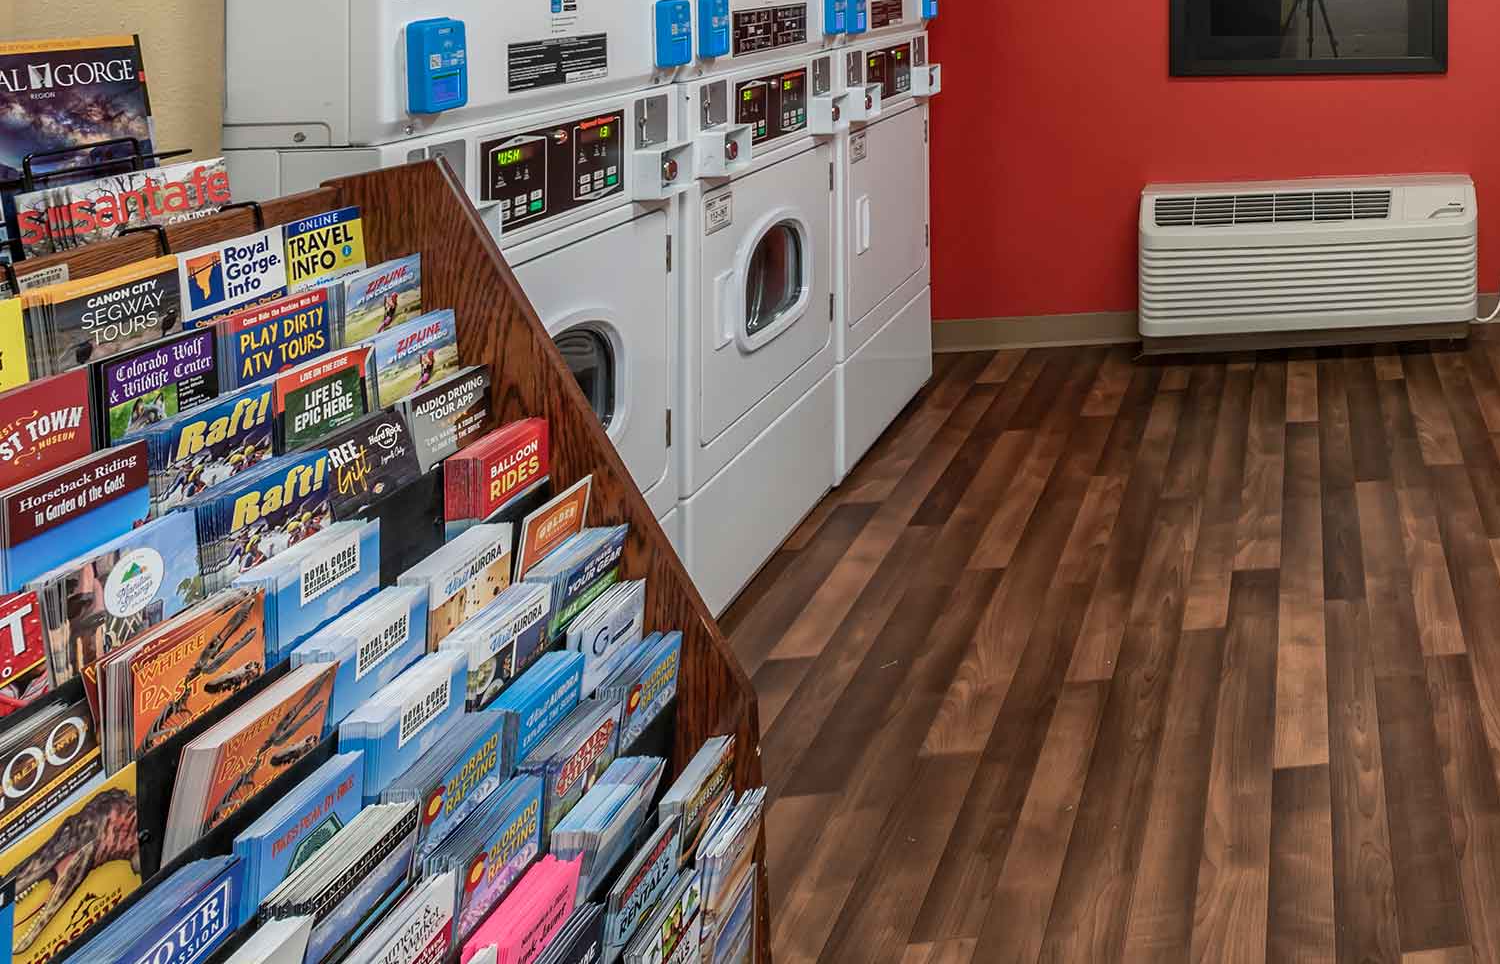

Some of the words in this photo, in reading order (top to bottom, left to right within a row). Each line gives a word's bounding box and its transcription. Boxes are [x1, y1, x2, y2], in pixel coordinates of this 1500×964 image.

[54, 59, 135, 87] GORGE
[288, 225, 353, 259] TRAVEL
[298, 212, 339, 233] ONLINE
[223, 236, 269, 263] Royal
[226, 253, 281, 281] Gorge.
[293, 251, 336, 280] INFO
[87, 289, 130, 308] CANON
[132, 279, 158, 298] CITY
[228, 277, 261, 298] info
[365, 264, 408, 296] ZIPLINE
[81, 290, 164, 330] SEGWAY
[90, 311, 158, 345] TOURS
[240, 322, 277, 353] PLAY
[282, 306, 325, 337] DIRTY
[242, 353, 275, 379] ATV
[279, 331, 325, 365] TOURS
[396, 321, 441, 352] ZIPLINE
[115, 351, 168, 382] Colorado
[172, 335, 205, 361] Wolf
[122, 366, 169, 398] Wildlife
[174, 355, 213, 378] Center
[294, 407, 322, 433] EPIC
[323, 392, 354, 419] HERE
[304, 385, 329, 411] LIFE
[331, 380, 343, 399] IS
[415, 395, 446, 417] AUDIO
[447, 375, 484, 402] DRIVING
[429, 403, 455, 423] TOUR
[456, 392, 474, 411] APP
[25, 406, 84, 442] TOWN
[39, 431, 76, 449] MUSEUM
[176, 391, 272, 462] Raft!
[490, 440, 538, 479] BALLOON
[490, 456, 540, 502] RIDES
[18, 473, 92, 514] Horseback
[94, 455, 137, 478] Riding
[34, 512, 44, 528] in
[45, 497, 76, 522] Garden
[77, 492, 87, 509] of
[88, 486, 103, 502] the
[104, 473, 126, 496] Gods!
[230, 456, 328, 534] Raft!
[304, 561, 329, 585] ROYAL
[330, 544, 357, 568] GORGE
[304, 570, 330, 593] BRIDGE
[338, 556, 357, 574] PARK
[469, 544, 502, 578] AURORA
[568, 567, 596, 596] YOUR
[597, 546, 623, 573] GEAR
[360, 637, 382, 659] ROYAL
[384, 614, 407, 639] GORGE
[511, 605, 543, 636] AURORA
[139, 678, 203, 714] PAST
[402, 704, 424, 725] ROYAL
[425, 681, 448, 707] GORGE
[445, 748, 497, 816] RAFTING
[487, 819, 537, 885] RAFTING
[618, 857, 670, 940] RENTALS
